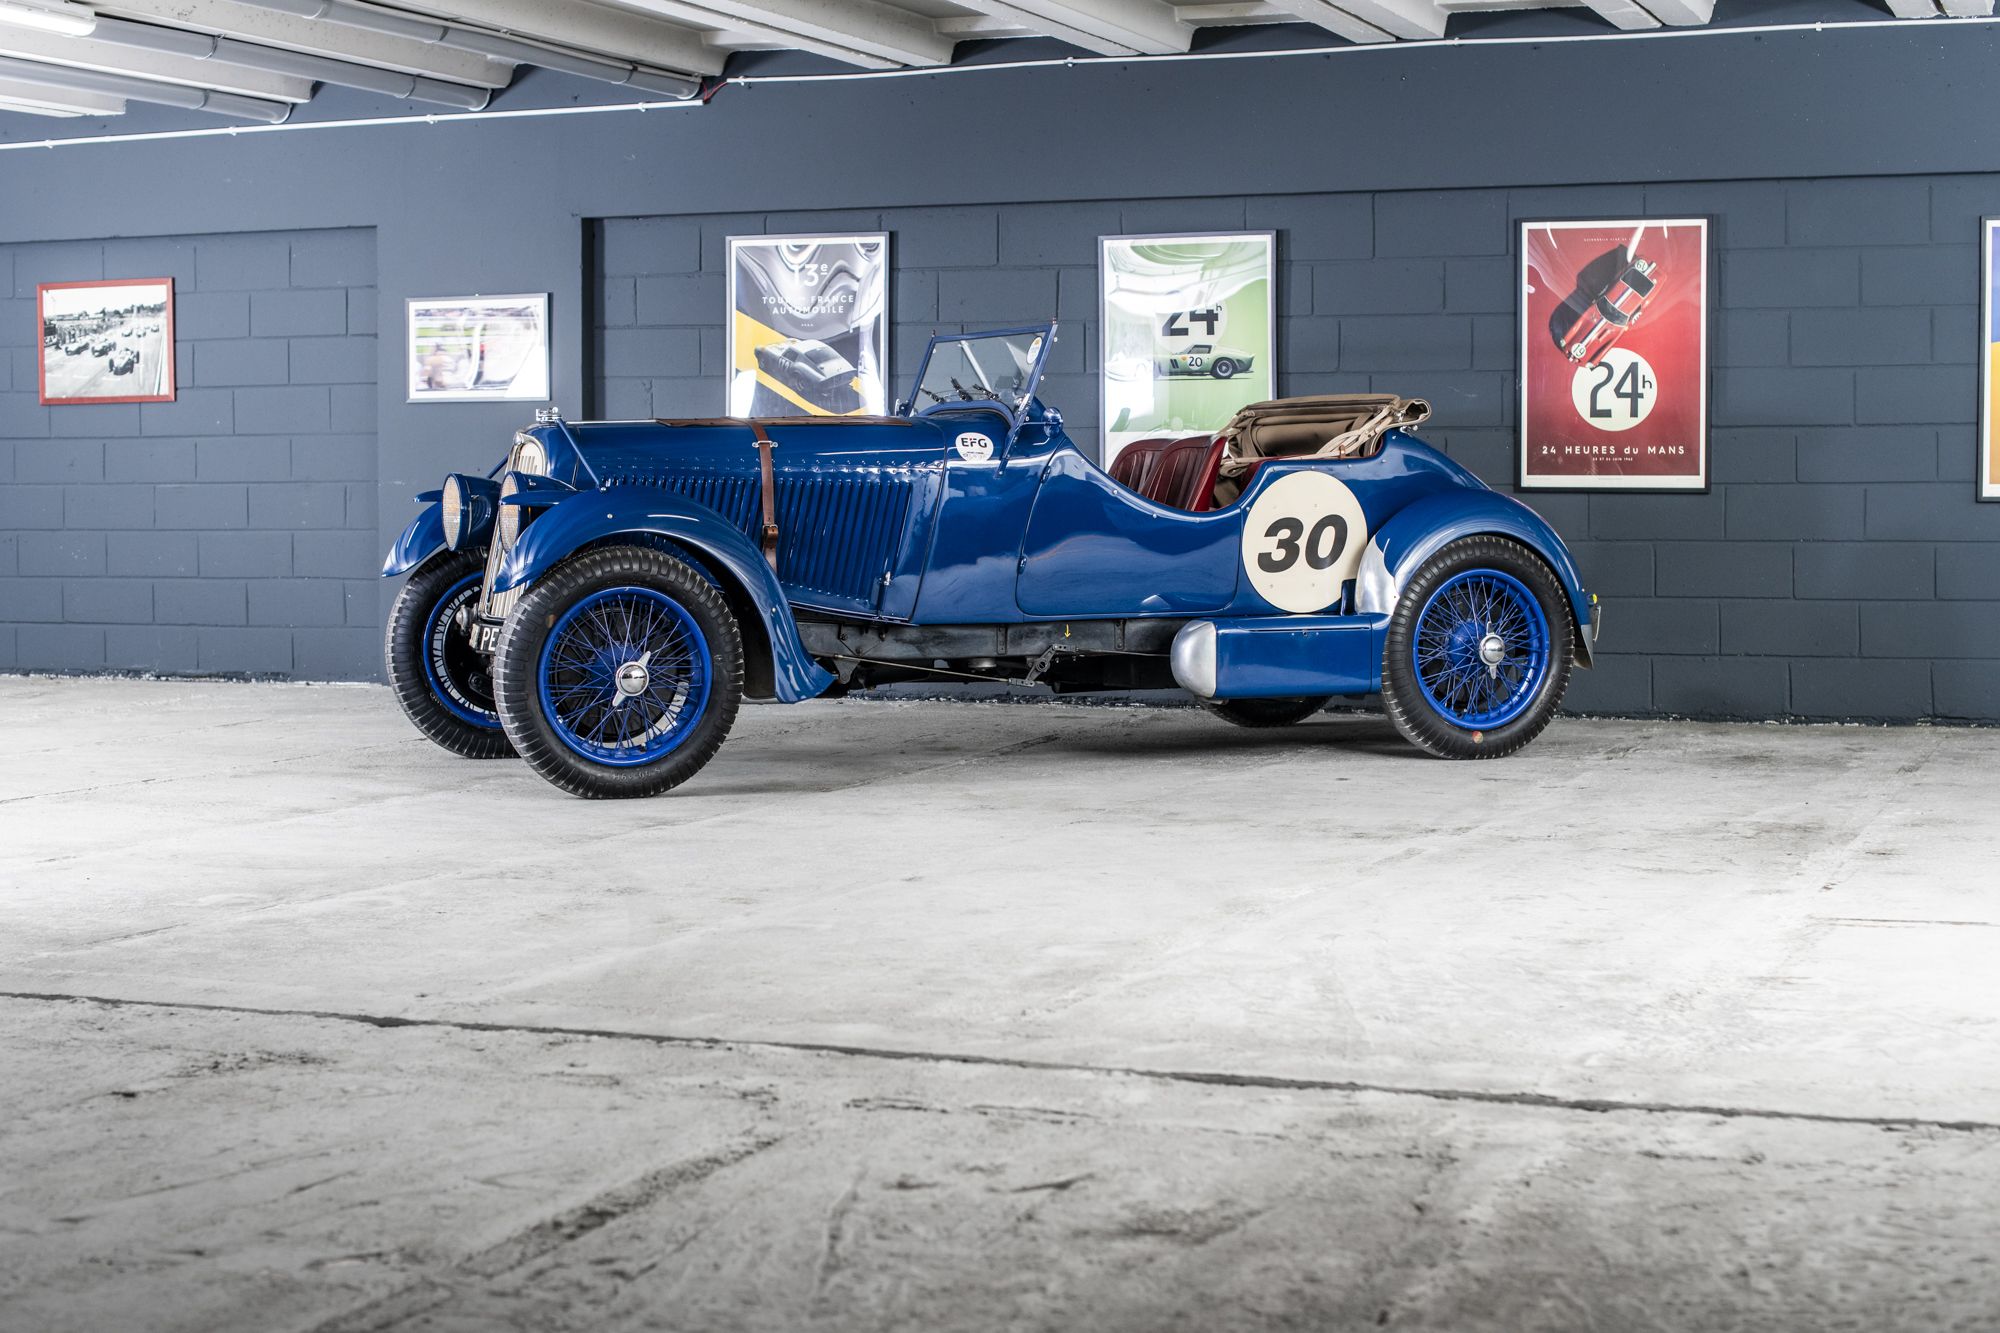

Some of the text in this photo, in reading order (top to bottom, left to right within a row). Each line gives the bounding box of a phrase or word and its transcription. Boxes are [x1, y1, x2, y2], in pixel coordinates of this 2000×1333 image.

[811, 295, 854, 303] FRANCE
[1188, 356, 1203, 368] 20
[1589, 361, 1652, 418] 24h
[961, 437, 987, 448] EFG
[1542, 445, 1685, 455] 24 HEURES du MANS
[1257, 514, 1348, 573] 30
[480, 627, 499, 652] PE
